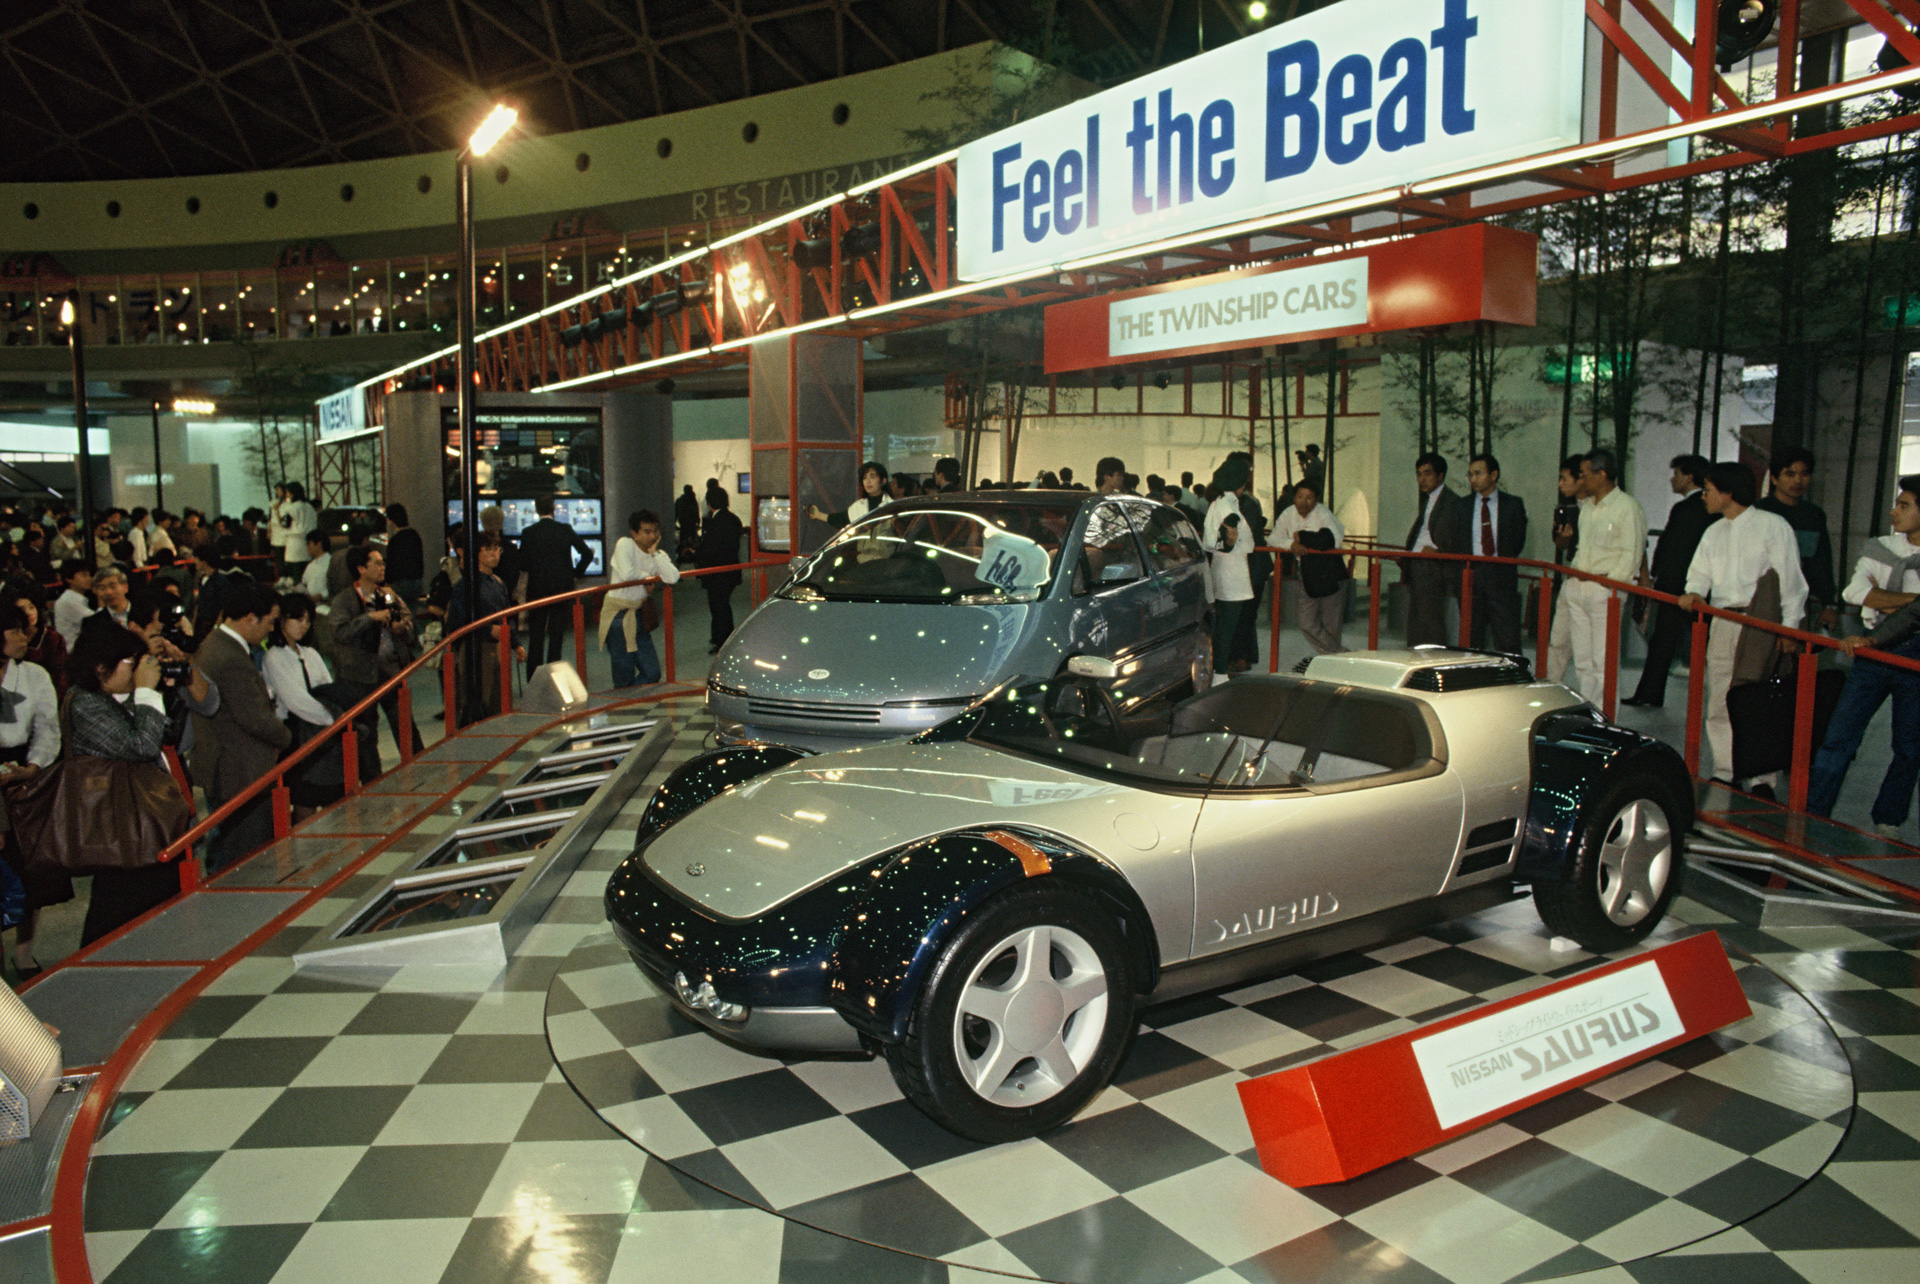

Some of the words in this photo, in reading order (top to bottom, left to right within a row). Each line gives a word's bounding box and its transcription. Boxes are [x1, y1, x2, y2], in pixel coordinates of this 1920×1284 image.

[992, 113, 1100, 254] Feel
[1126, 87, 1236, 216] the
[1265, 0, 1479, 183] Beat
[8, 289, 193, 324] レトラン
[1117, 312, 1154, 340] THE
[1159, 291, 1278, 335] TWINSHIP
[1283, 278, 1357, 315] CARS
[1205, 892, 1339, 945] SAURUS
[1450, 1051, 1514, 1089] NISSAN
[1513, 1002, 1661, 1082] SAURUS
